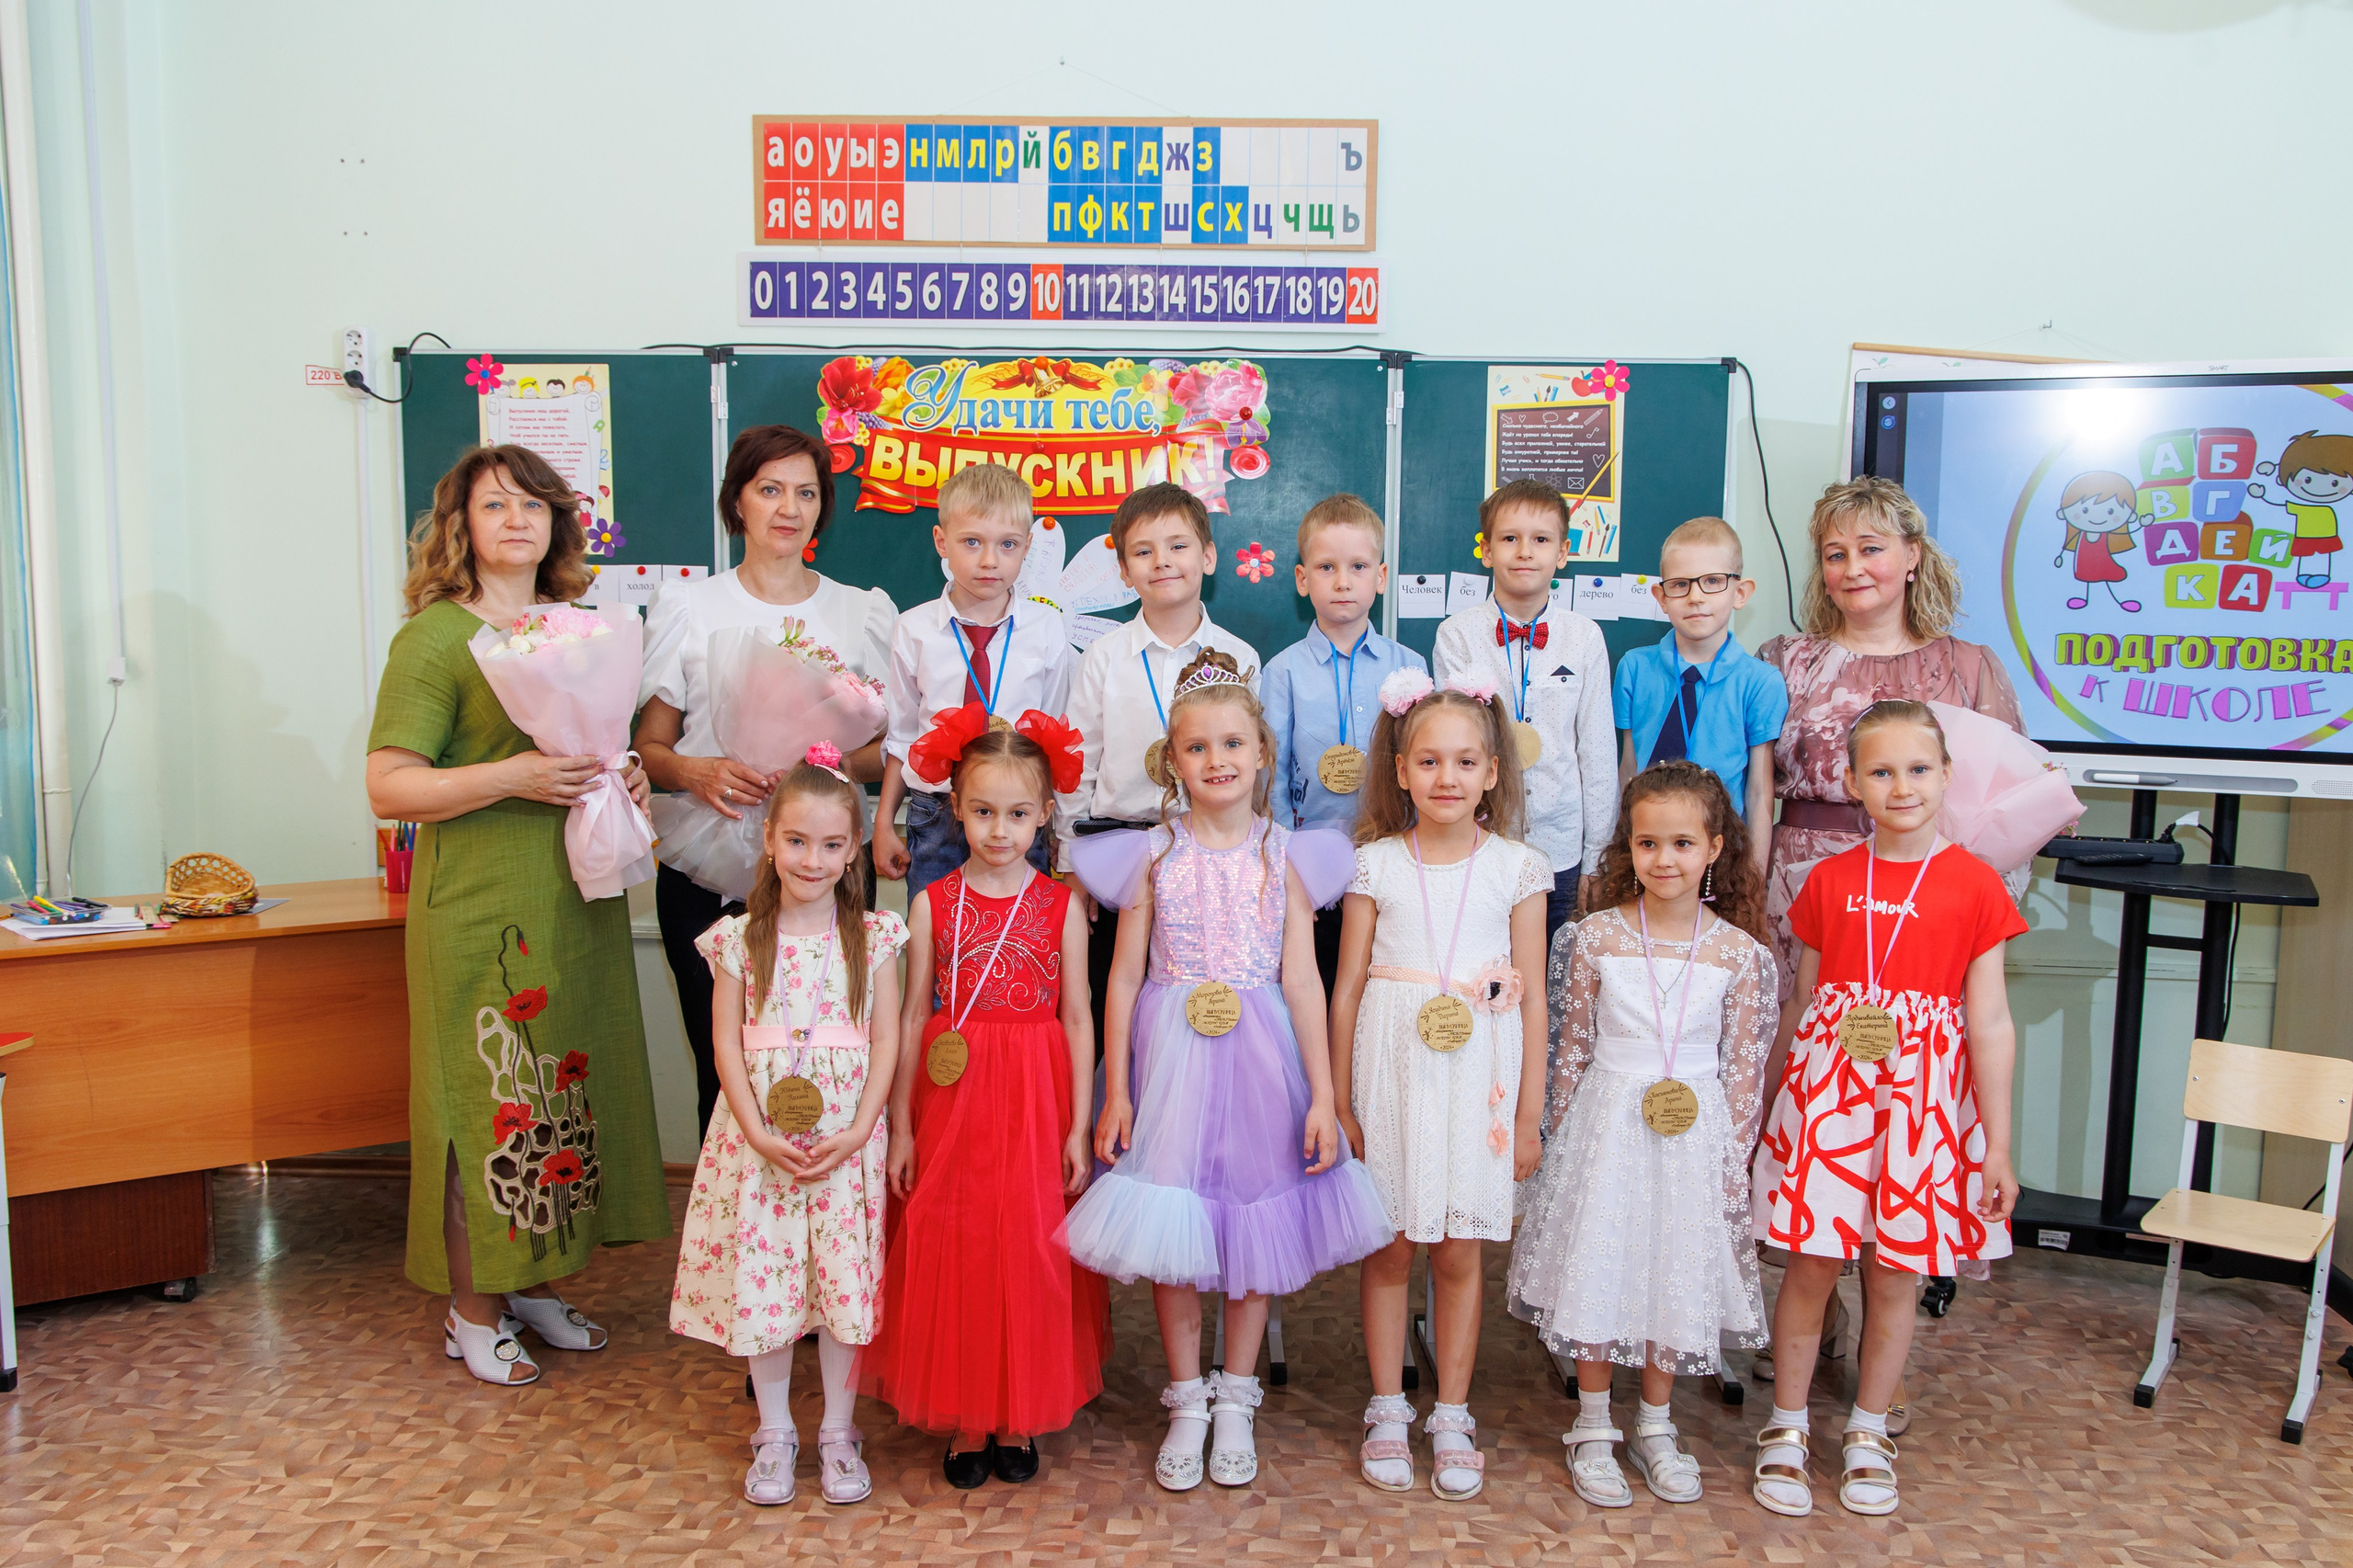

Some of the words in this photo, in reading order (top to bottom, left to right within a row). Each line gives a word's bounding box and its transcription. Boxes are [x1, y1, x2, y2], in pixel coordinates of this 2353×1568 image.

[755, 271, 772, 309] 0
[785, 272, 796, 309] 1
[812, 271, 829, 309] 2
[840, 271, 857, 310] 3
[867, 272, 886, 310] 4
[895, 272, 912, 310] 5
[923, 272, 941, 311] 6
[952, 273, 969, 310] 7
[980, 272, 998, 311] 8
[1007, 273, 1026, 311] 9
[1035, 273, 1060, 311] 10
[1066, 274, 1089, 312] 11
[1096, 274, 1122, 312] 12
[1128, 273, 1155, 312] 13
[1160, 275, 1186, 312] 14
[1191, 275, 1217, 313] 15
[1222, 276, 1249, 313] 16
[1254, 276, 1280, 313] 17
[1286, 276, 1312, 314] 18
[1317, 277, 1344, 314] 19
[1348, 277, 1377, 315] 20
[311, 369, 331, 381] 220
[333, 371, 343, 381] В
[903, 362, 1053, 435] Удачи
[1066, 388, 1162, 436] тебе,
[1402, 585, 1442, 594] Человек
[1460, 585, 1476, 597] без
[1580, 590, 1614, 599] дерево
[1631, 585, 1647, 595] без
[2054, 633, 2353, 673] ПОДГОТОВКА
[2122, 677, 2331, 722] ШКОЛЕ
